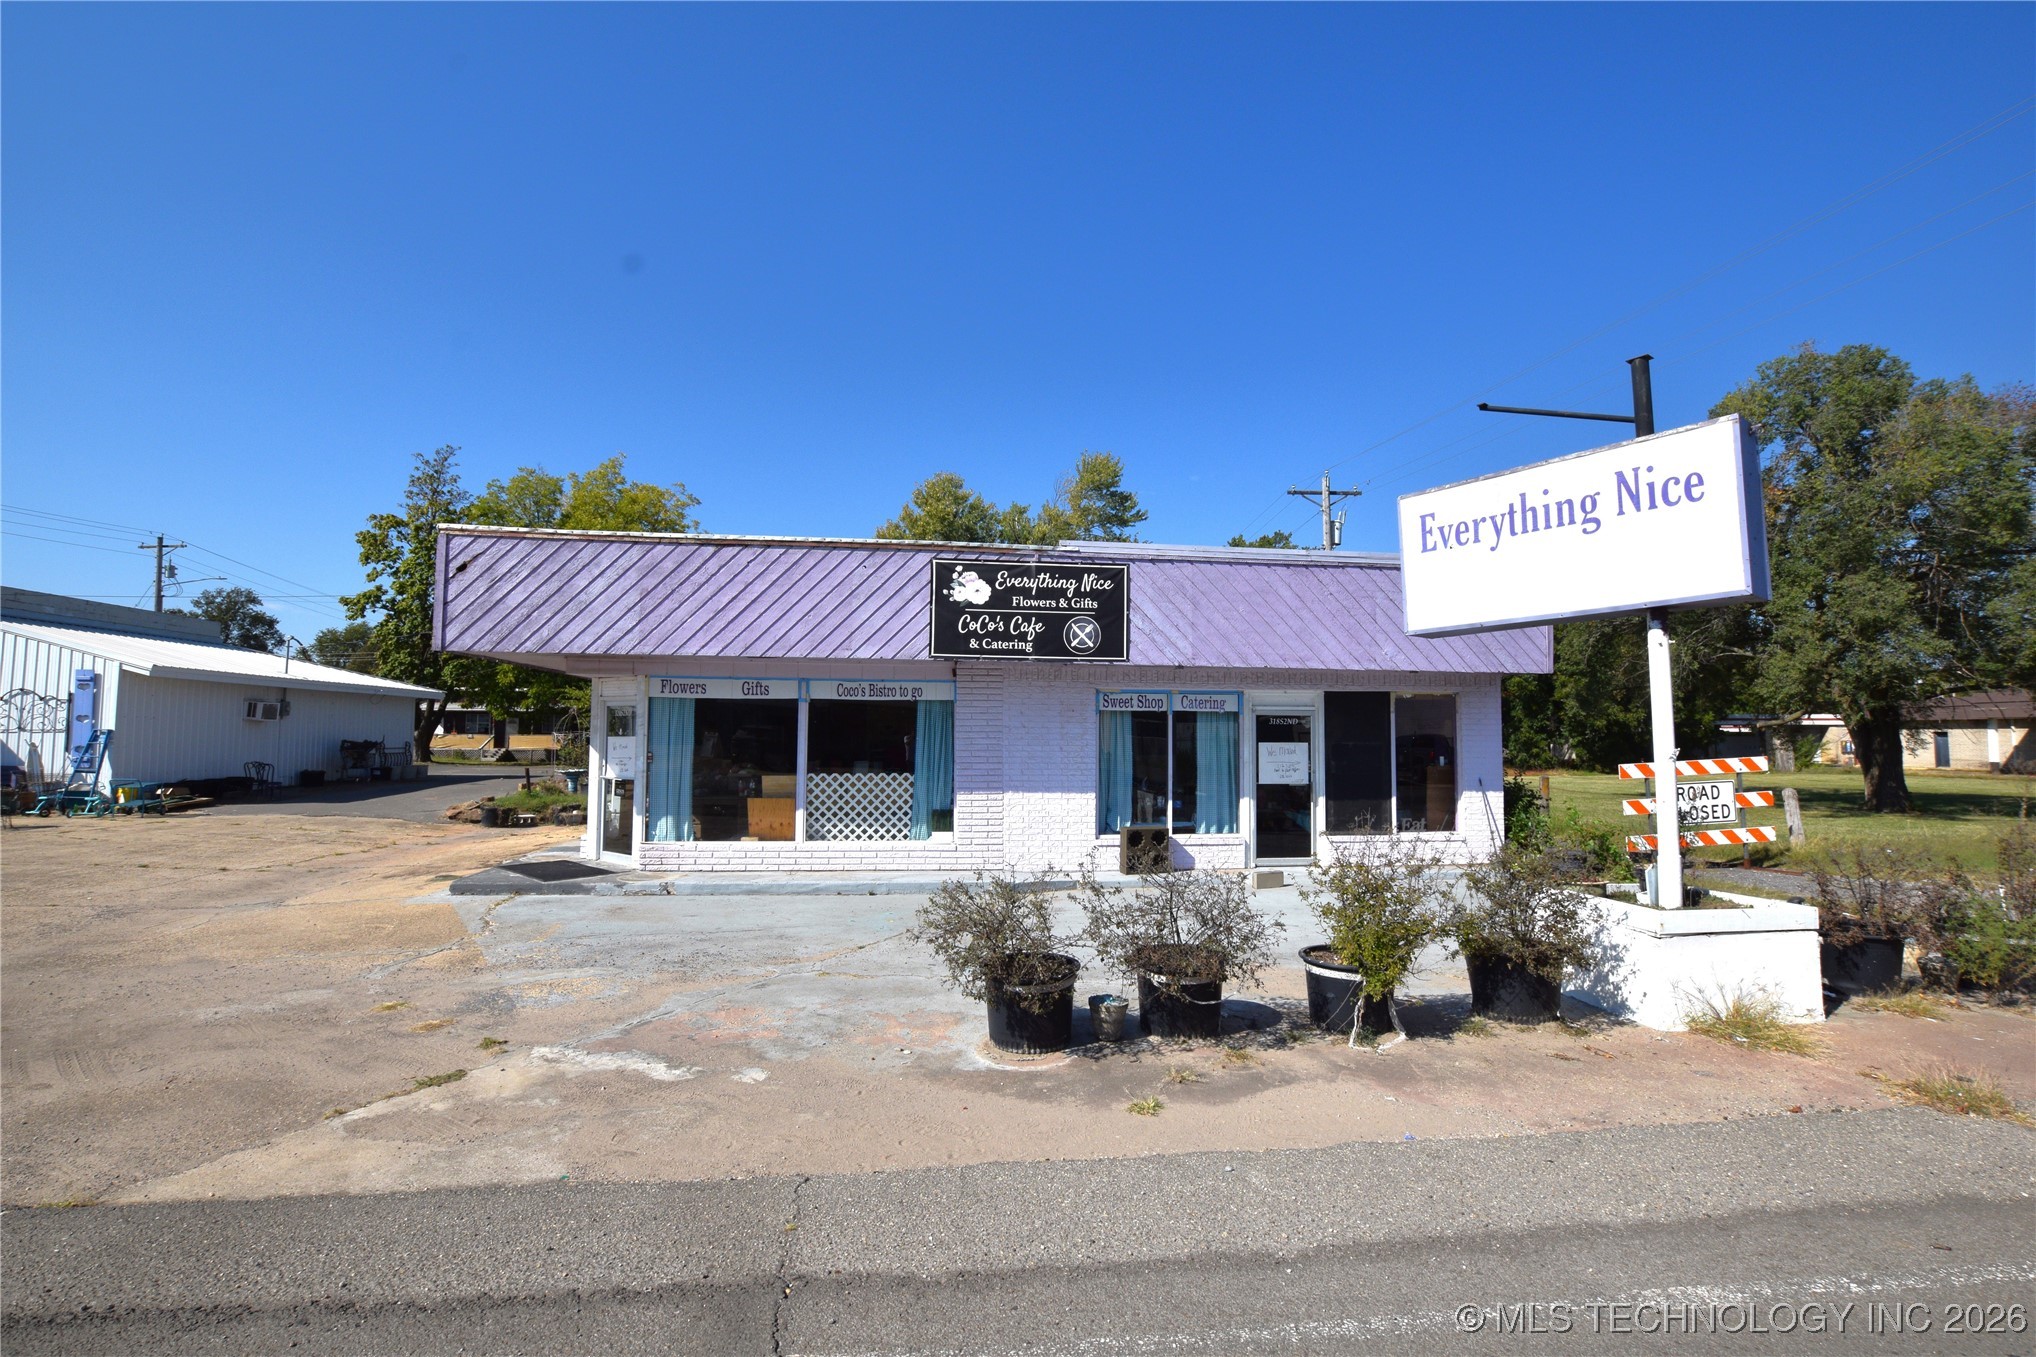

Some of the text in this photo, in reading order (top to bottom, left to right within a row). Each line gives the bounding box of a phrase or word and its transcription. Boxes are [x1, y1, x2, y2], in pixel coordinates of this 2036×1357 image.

[1419, 465, 1705, 554] Everything Nice
[995, 570, 1114, 598] Everything Nice
[1012, 596, 1098, 609] Flowers & Gifts
[957, 614, 1046, 641] CoCo's Cafe
[969, 638, 1034, 653] & Catering
[660, 679, 770, 696] Flowers Gifts
[836, 682, 923, 702] Coco's Bistro to go
[1102, 694, 1164, 712] Sweet Shop
[1181, 695, 1227, 714] Catering
[1677, 785, 1720, 802] ROAD
[1687, 804, 1731, 821] OSED
[1400, 817, 1427, 832] Eat
